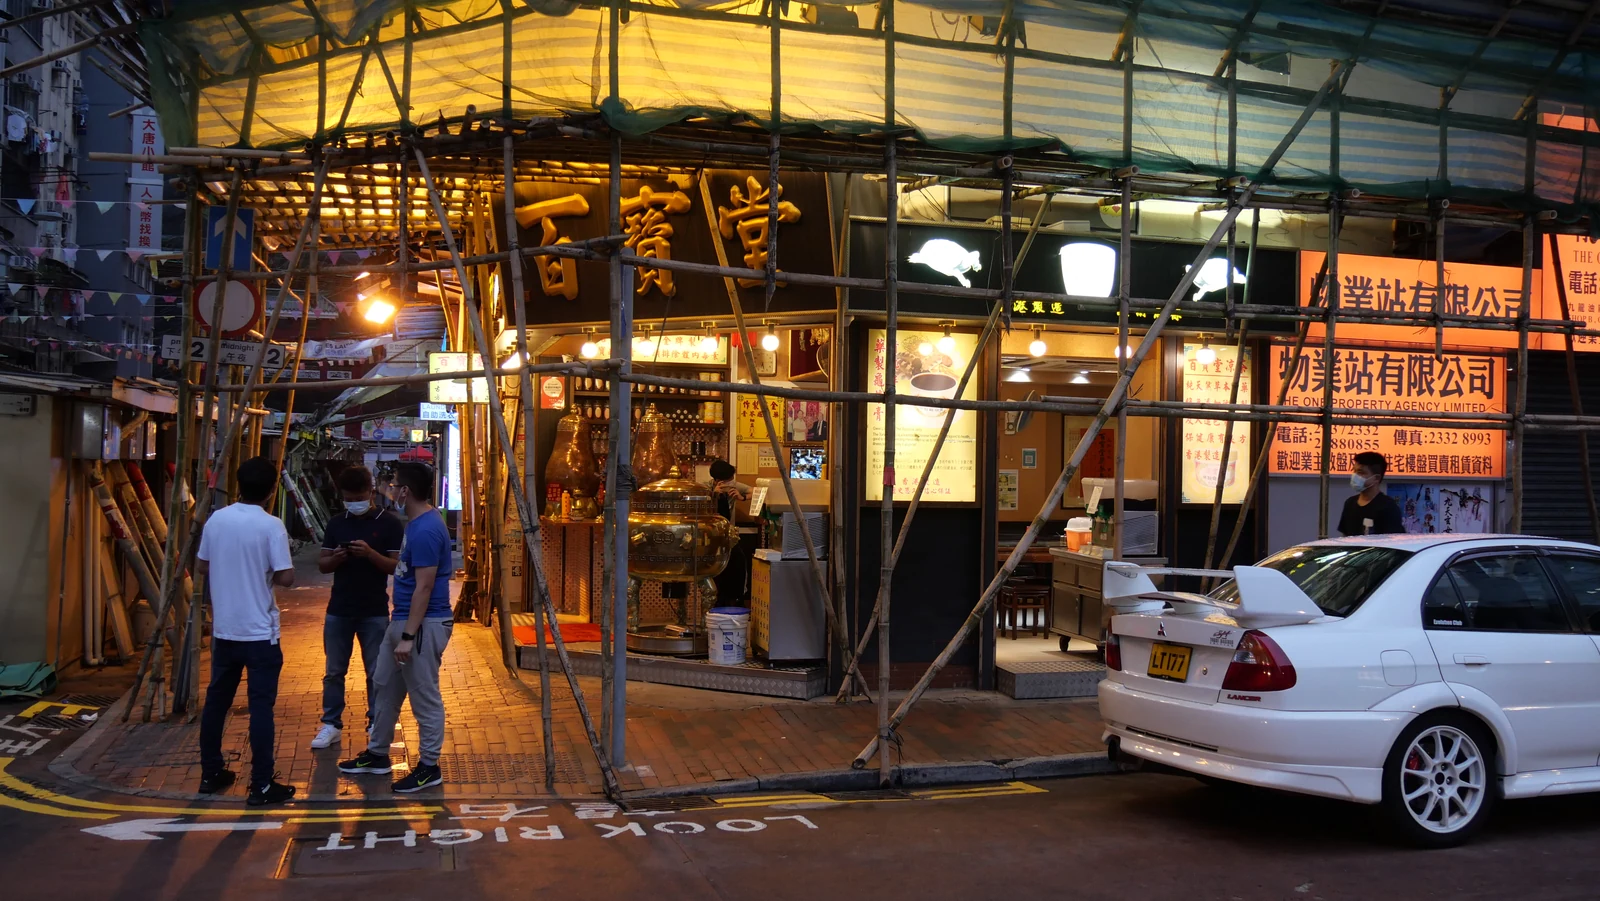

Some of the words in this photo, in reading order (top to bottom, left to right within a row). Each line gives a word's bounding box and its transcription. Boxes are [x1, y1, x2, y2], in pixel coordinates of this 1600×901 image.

[139, 187, 152, 247] 人幣找換
[1573, 250, 1593, 263] THE
[1001, 300, 1065, 315] 港製造
[873, 338, 886, 422] 藥製龜膏
[1279, 347, 1495, 399] 物業站有限公司
[1186, 380, 1249, 393] 純天然草本藥
[743, 400, 779, 411] 金製作
[1277, 396, 1299, 406] HE
[1303, 397, 1325, 407] ONE
[1332, 398, 1392, 410] PROPERTY
[1395, 400, 1441, 412] AGENCY
[1444, 402, 1486, 413] LIMITED
[1314, 423, 1379, 436] 2372332
[1185, 433, 1247, 444] 保健康有方
[1314, 437, 1380, 451] 2880855
[1227, 694, 1262, 702] LANCER
[595, 814, 819, 839] LOOK
[317, 825, 564, 850] RIGHT
